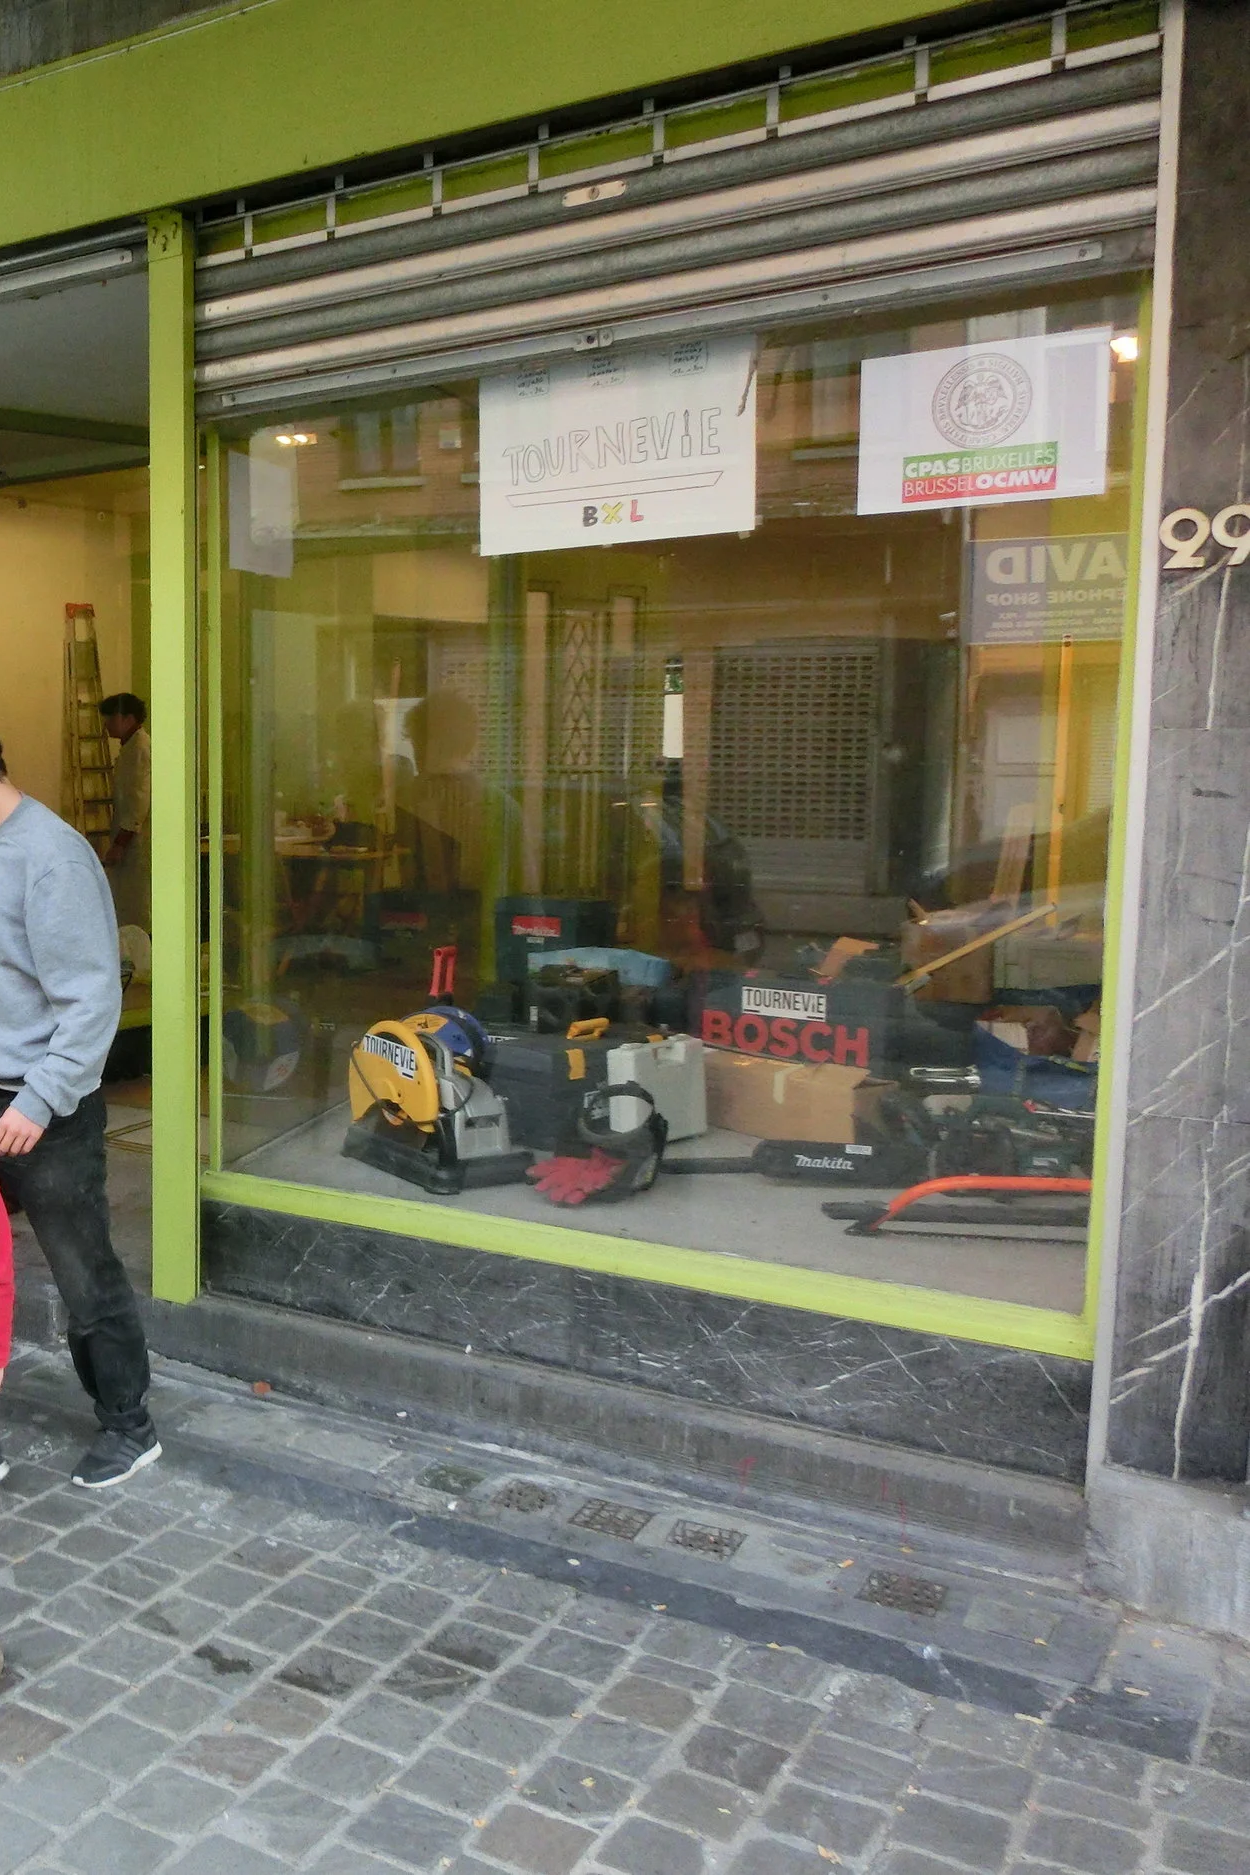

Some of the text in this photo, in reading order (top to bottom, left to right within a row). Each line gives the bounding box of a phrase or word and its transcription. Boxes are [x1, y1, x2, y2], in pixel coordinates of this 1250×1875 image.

[502, 406, 722, 486] TOURNEVIE
[904, 449, 1056, 478] CPAS BRUXELLES
[904, 467, 1055, 498] BRUSSEL OCMW
[582, 499, 645, 528] BXL
[744, 988, 825, 1013] TOURNEVIE
[364, 1034, 415, 1071] TOURNEVIE
[701, 1009, 870, 1067] BOSCH
